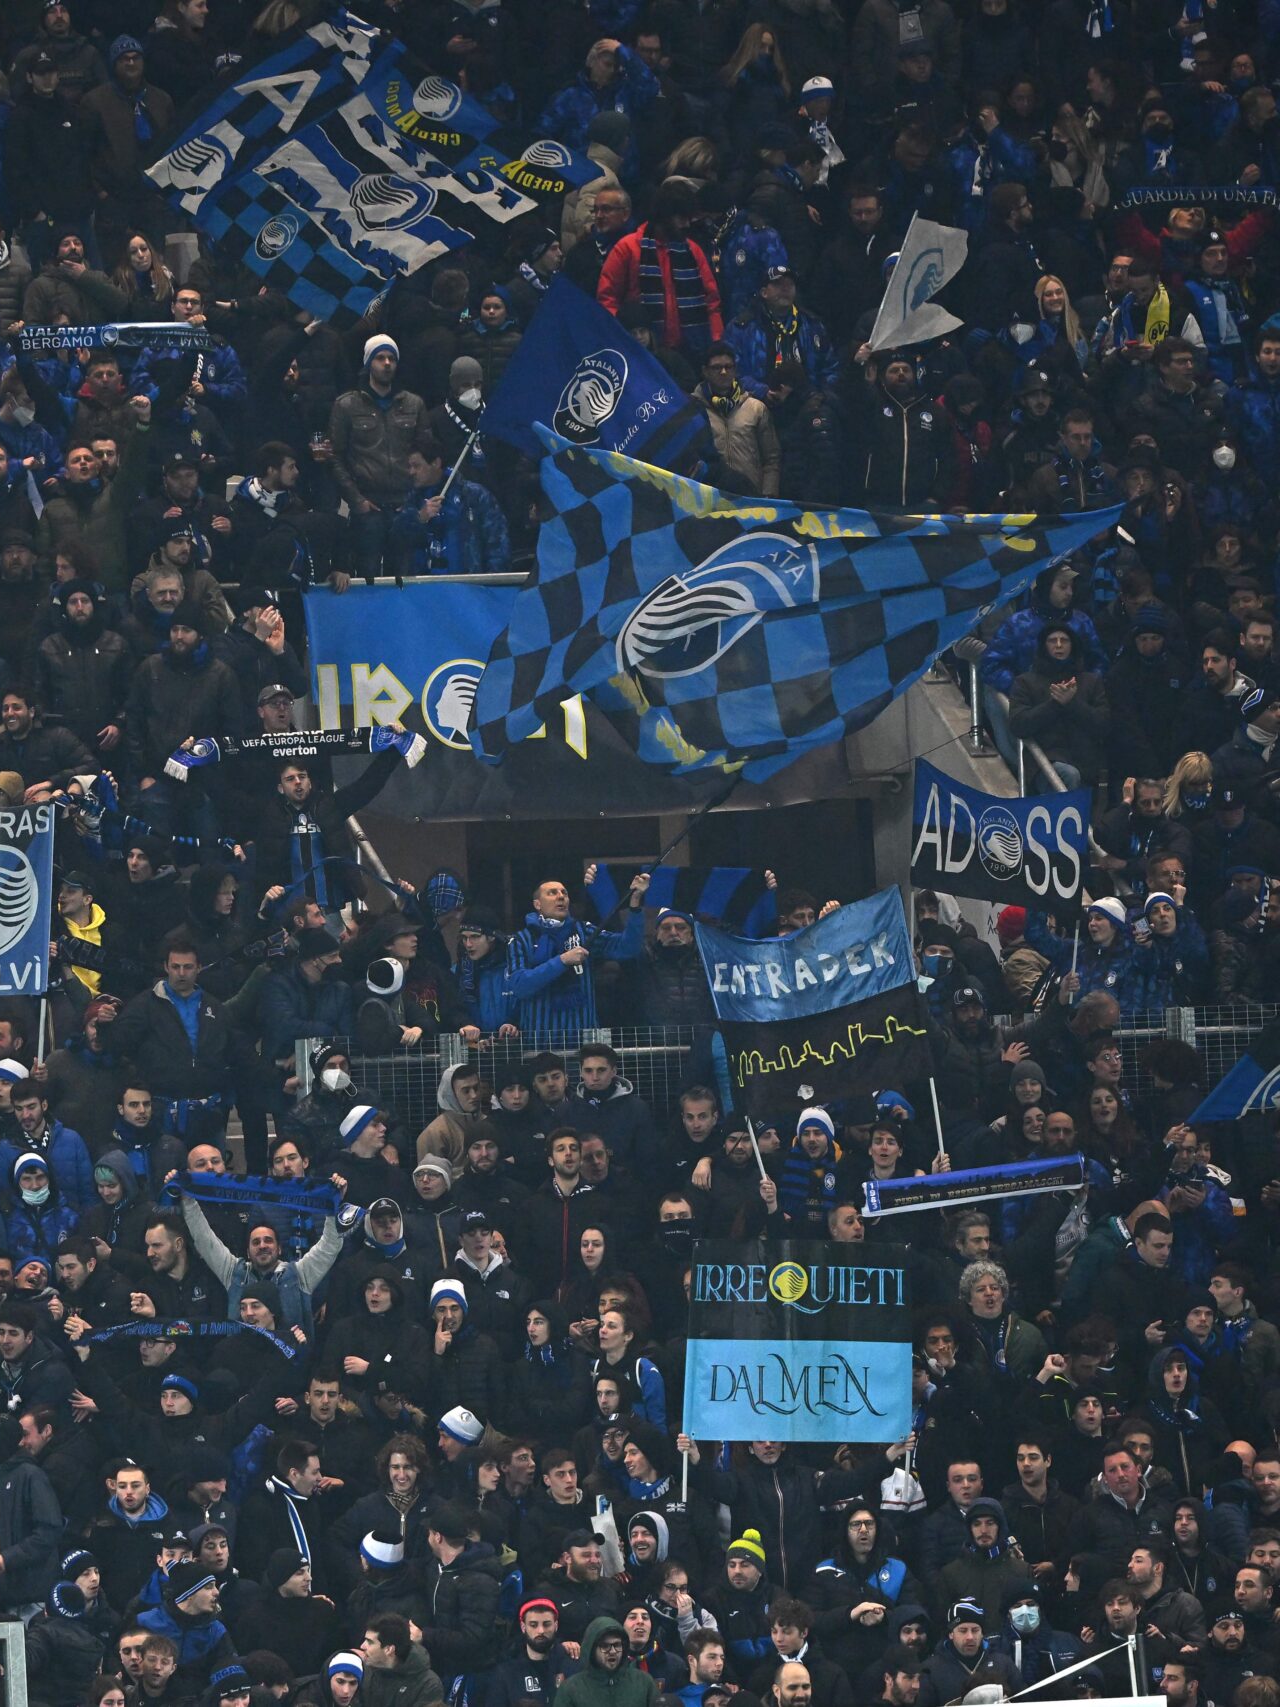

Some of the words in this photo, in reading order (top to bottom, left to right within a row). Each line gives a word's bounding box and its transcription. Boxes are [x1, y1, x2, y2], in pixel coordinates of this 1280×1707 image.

[21, 336, 93, 350] BERGAMO
[584, 359, 620, 389] ATALANTA
[564, 419, 586, 433] 1907
[242, 738, 267, 748] UEFA
[268, 736, 307, 747] EUROPA
[308, 733, 346, 744] LEAGUE
[272, 745, 318, 757] everton
[713, 931, 896, 999] ENTRADEK
[695, 1261, 905, 1315] IRREQUIETI
[709, 1353, 888, 1417] DALMEN
